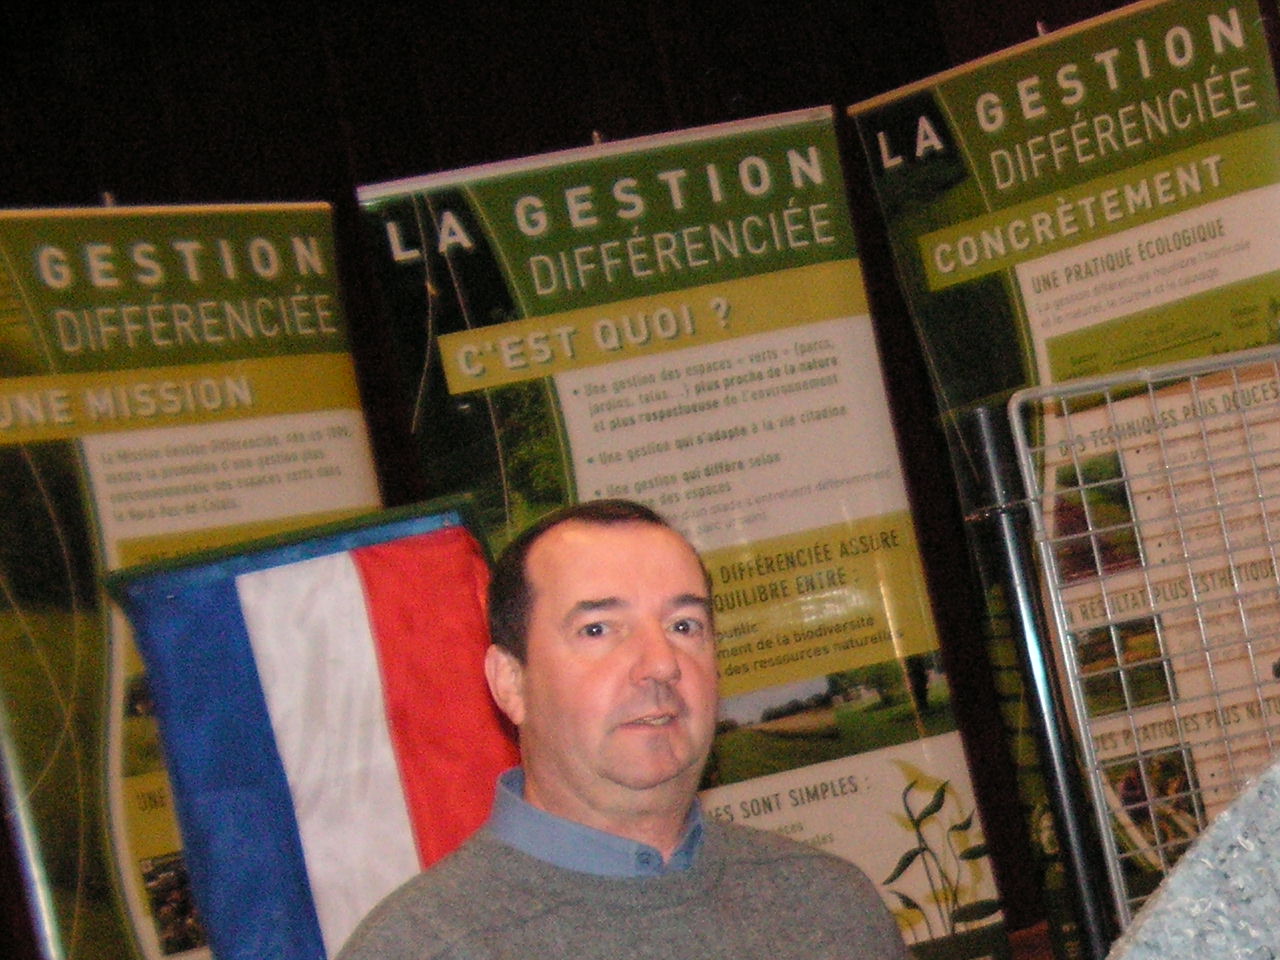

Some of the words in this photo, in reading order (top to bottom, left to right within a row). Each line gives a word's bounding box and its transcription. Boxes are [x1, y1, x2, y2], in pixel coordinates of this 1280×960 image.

[877, 115, 944, 169] LA
[975, 8, 1246, 133] GESTION
[989, 63, 1258, 190] DIFFÉRENCIÉE
[387, 210, 474, 263] LA
[514, 146, 826, 237] GESTION
[934, 154, 1224, 274] CONCRÈTEMENT
[38, 236, 328, 290] GESTION
[529, 197, 837, 296] DIFFÉRENCIÉE
[1031, 272, 1061, 294] UNE
[1064, 248, 1134, 285] PRATIQUE
[1138, 217, 1226, 261] ÉCOLOGIQUE
[54, 284, 339, 354] DIFFÉRENCIÉE
[456, 325, 578, 377] C'EST
[592, 305, 696, 351] QUOI
[711, 297, 733, 329] ?
[85, 375, 254, 421] MISSION
[719, 543, 832, 584] DIFFÉRENCIÉE
[838, 530, 900, 559] ASSURE
[795, 566, 847, 595] ENTRE
[724, 661, 751, 677] des
[753, 645, 830, 671] ressources
[756, 638, 773, 651] de
[776, 633, 790, 648] la
[793, 614, 875, 643] biodiversité
[739, 793, 783, 819] SONT
[789, 775, 858, 807] SIMPLES
